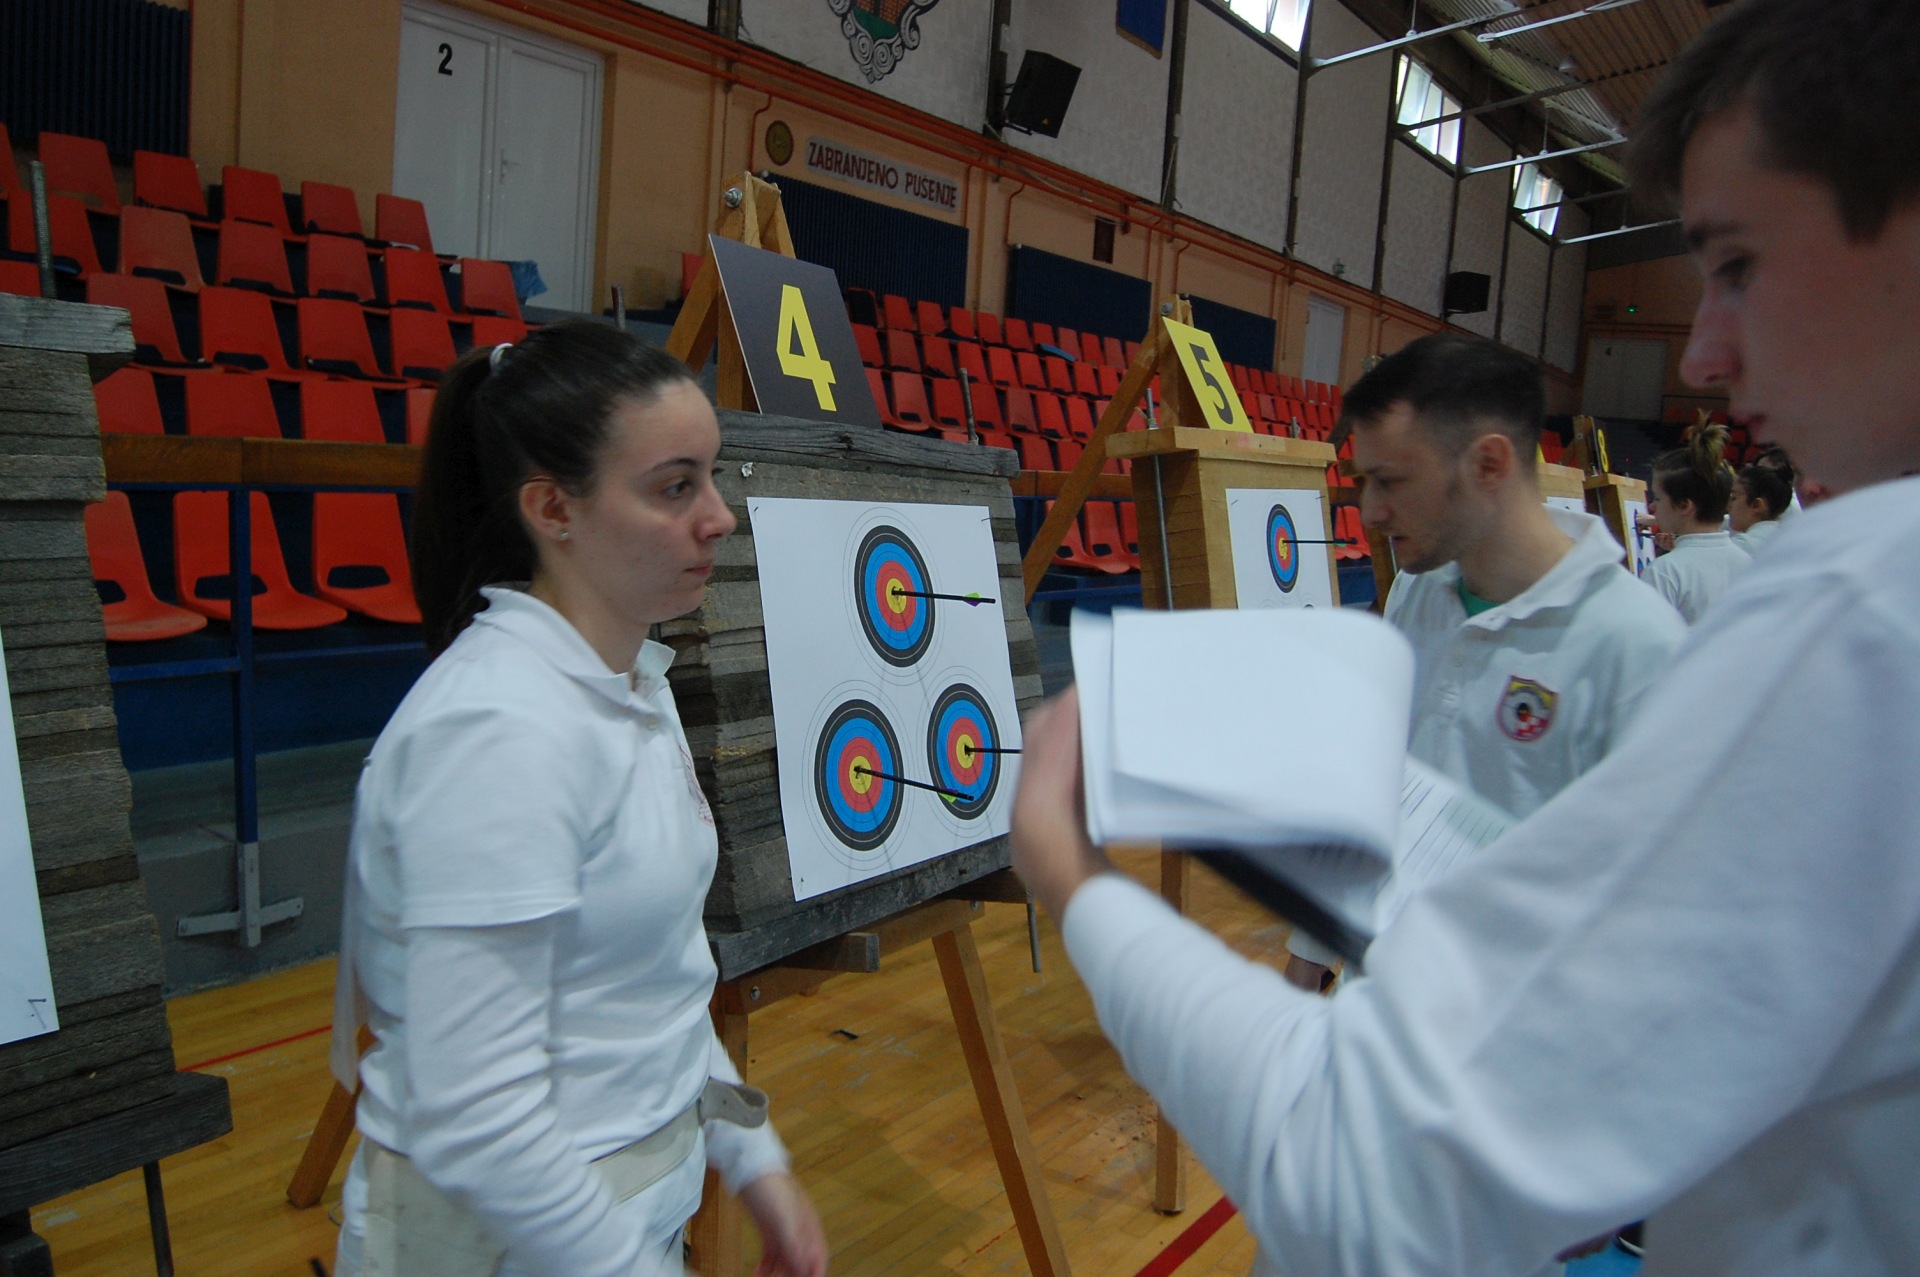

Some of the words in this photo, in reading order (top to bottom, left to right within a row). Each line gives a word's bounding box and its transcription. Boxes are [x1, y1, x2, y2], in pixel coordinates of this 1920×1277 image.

[438, 42, 453, 76] 2
[808, 142, 899, 189] ZABRANJENO
[776, 284, 837, 411] 4
[1189, 343, 1234, 425] 5
[1597, 428, 1609, 473] 8
